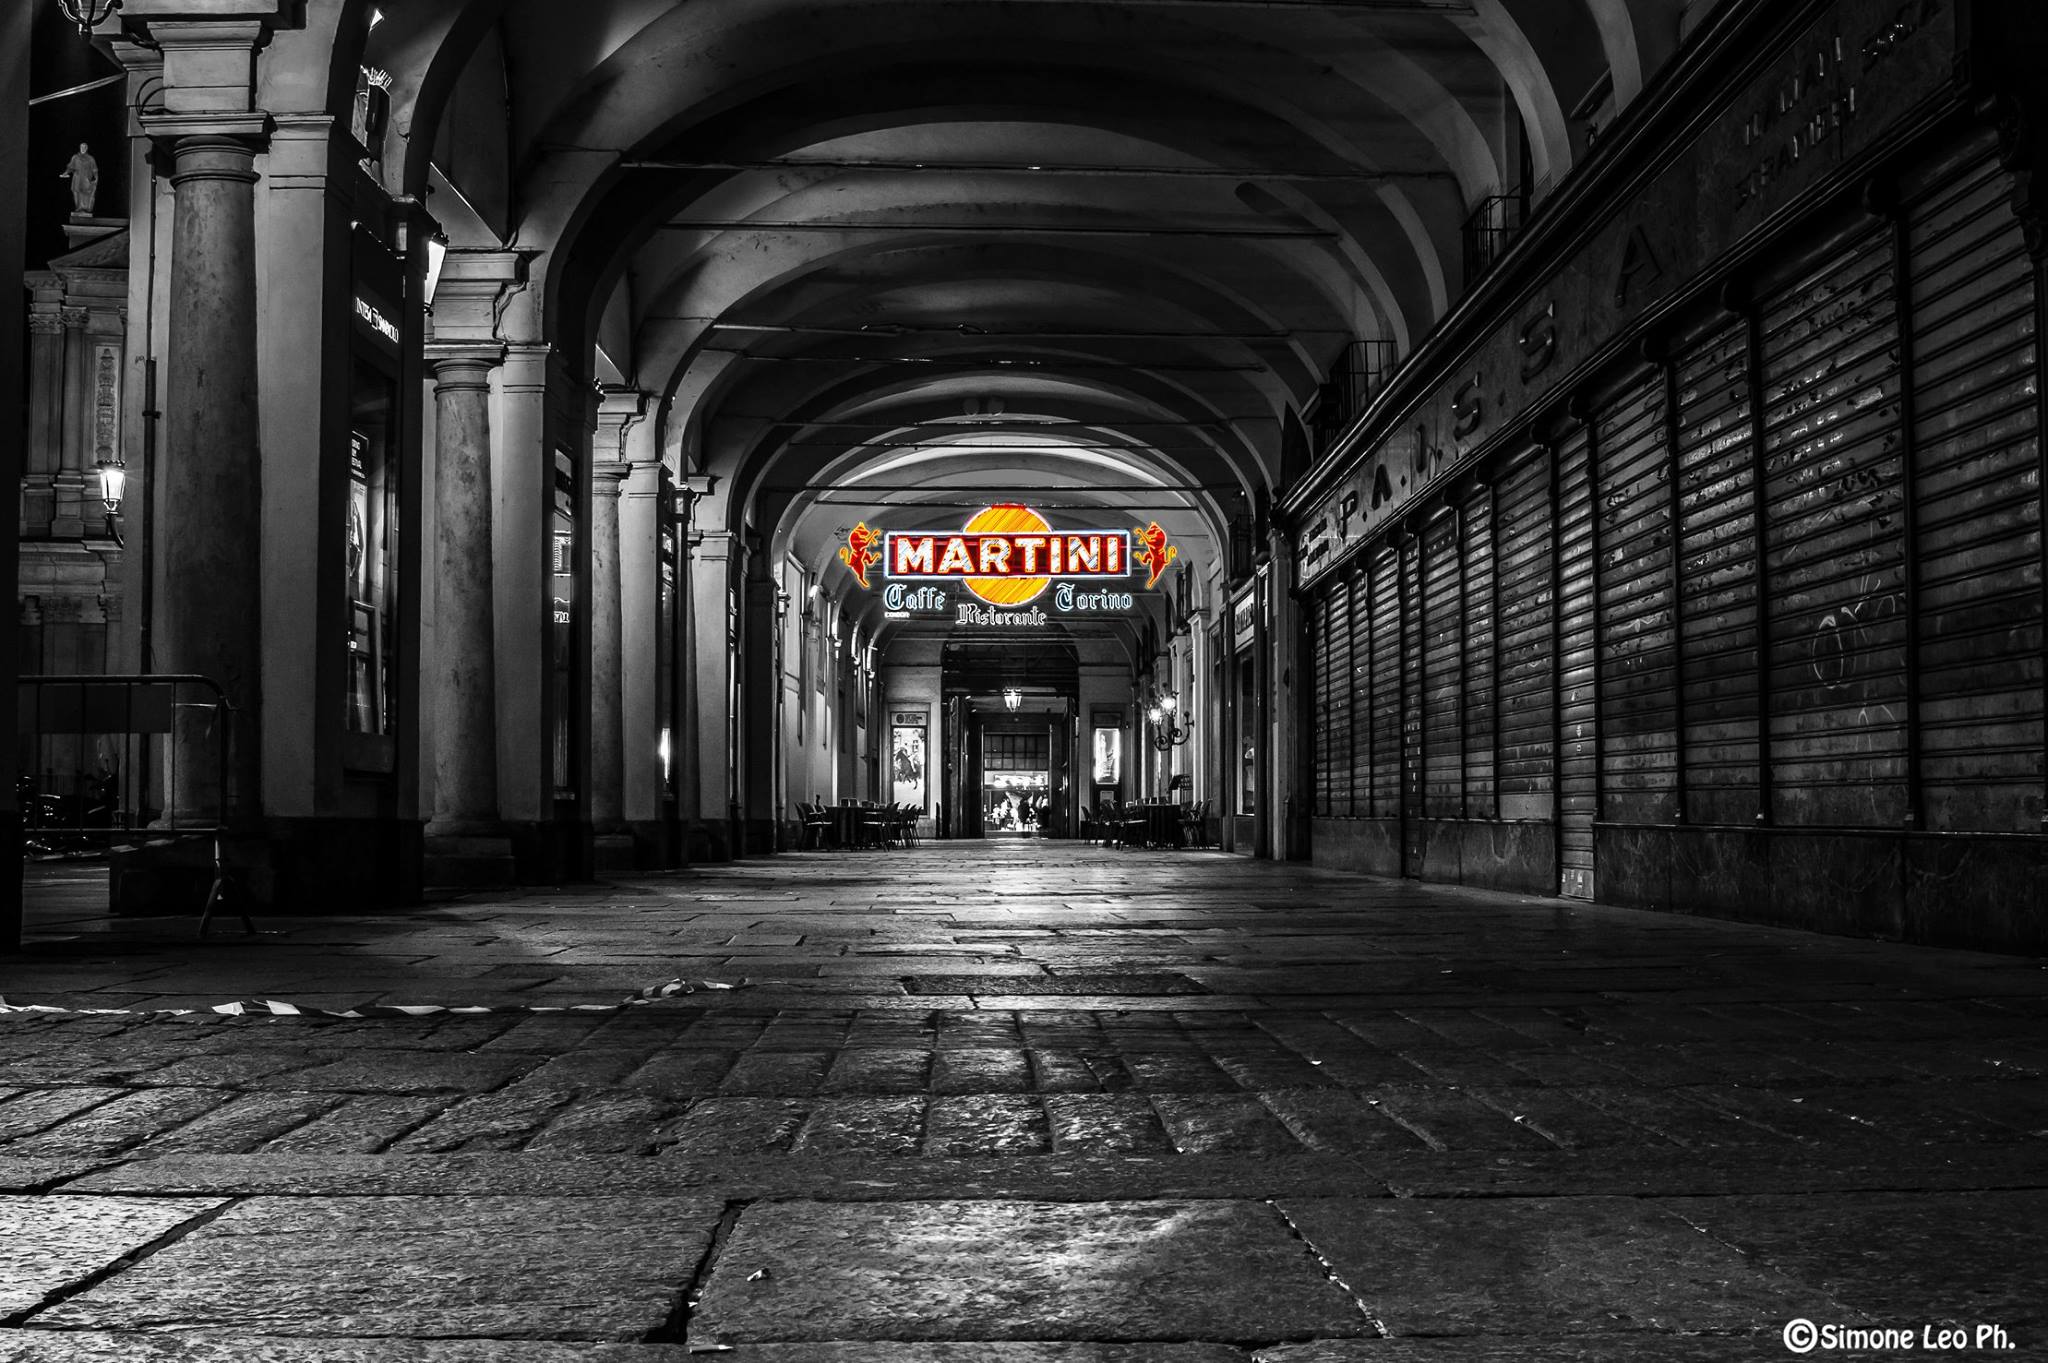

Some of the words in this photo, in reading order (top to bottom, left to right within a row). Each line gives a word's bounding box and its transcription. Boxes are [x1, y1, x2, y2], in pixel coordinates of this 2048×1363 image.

[896, 536, 1119, 574] MARTINI
[884, 583, 946, 610] Caffè
[1056, 582, 1132, 612] Torino
[955, 603, 1047, 626] Ristorante
